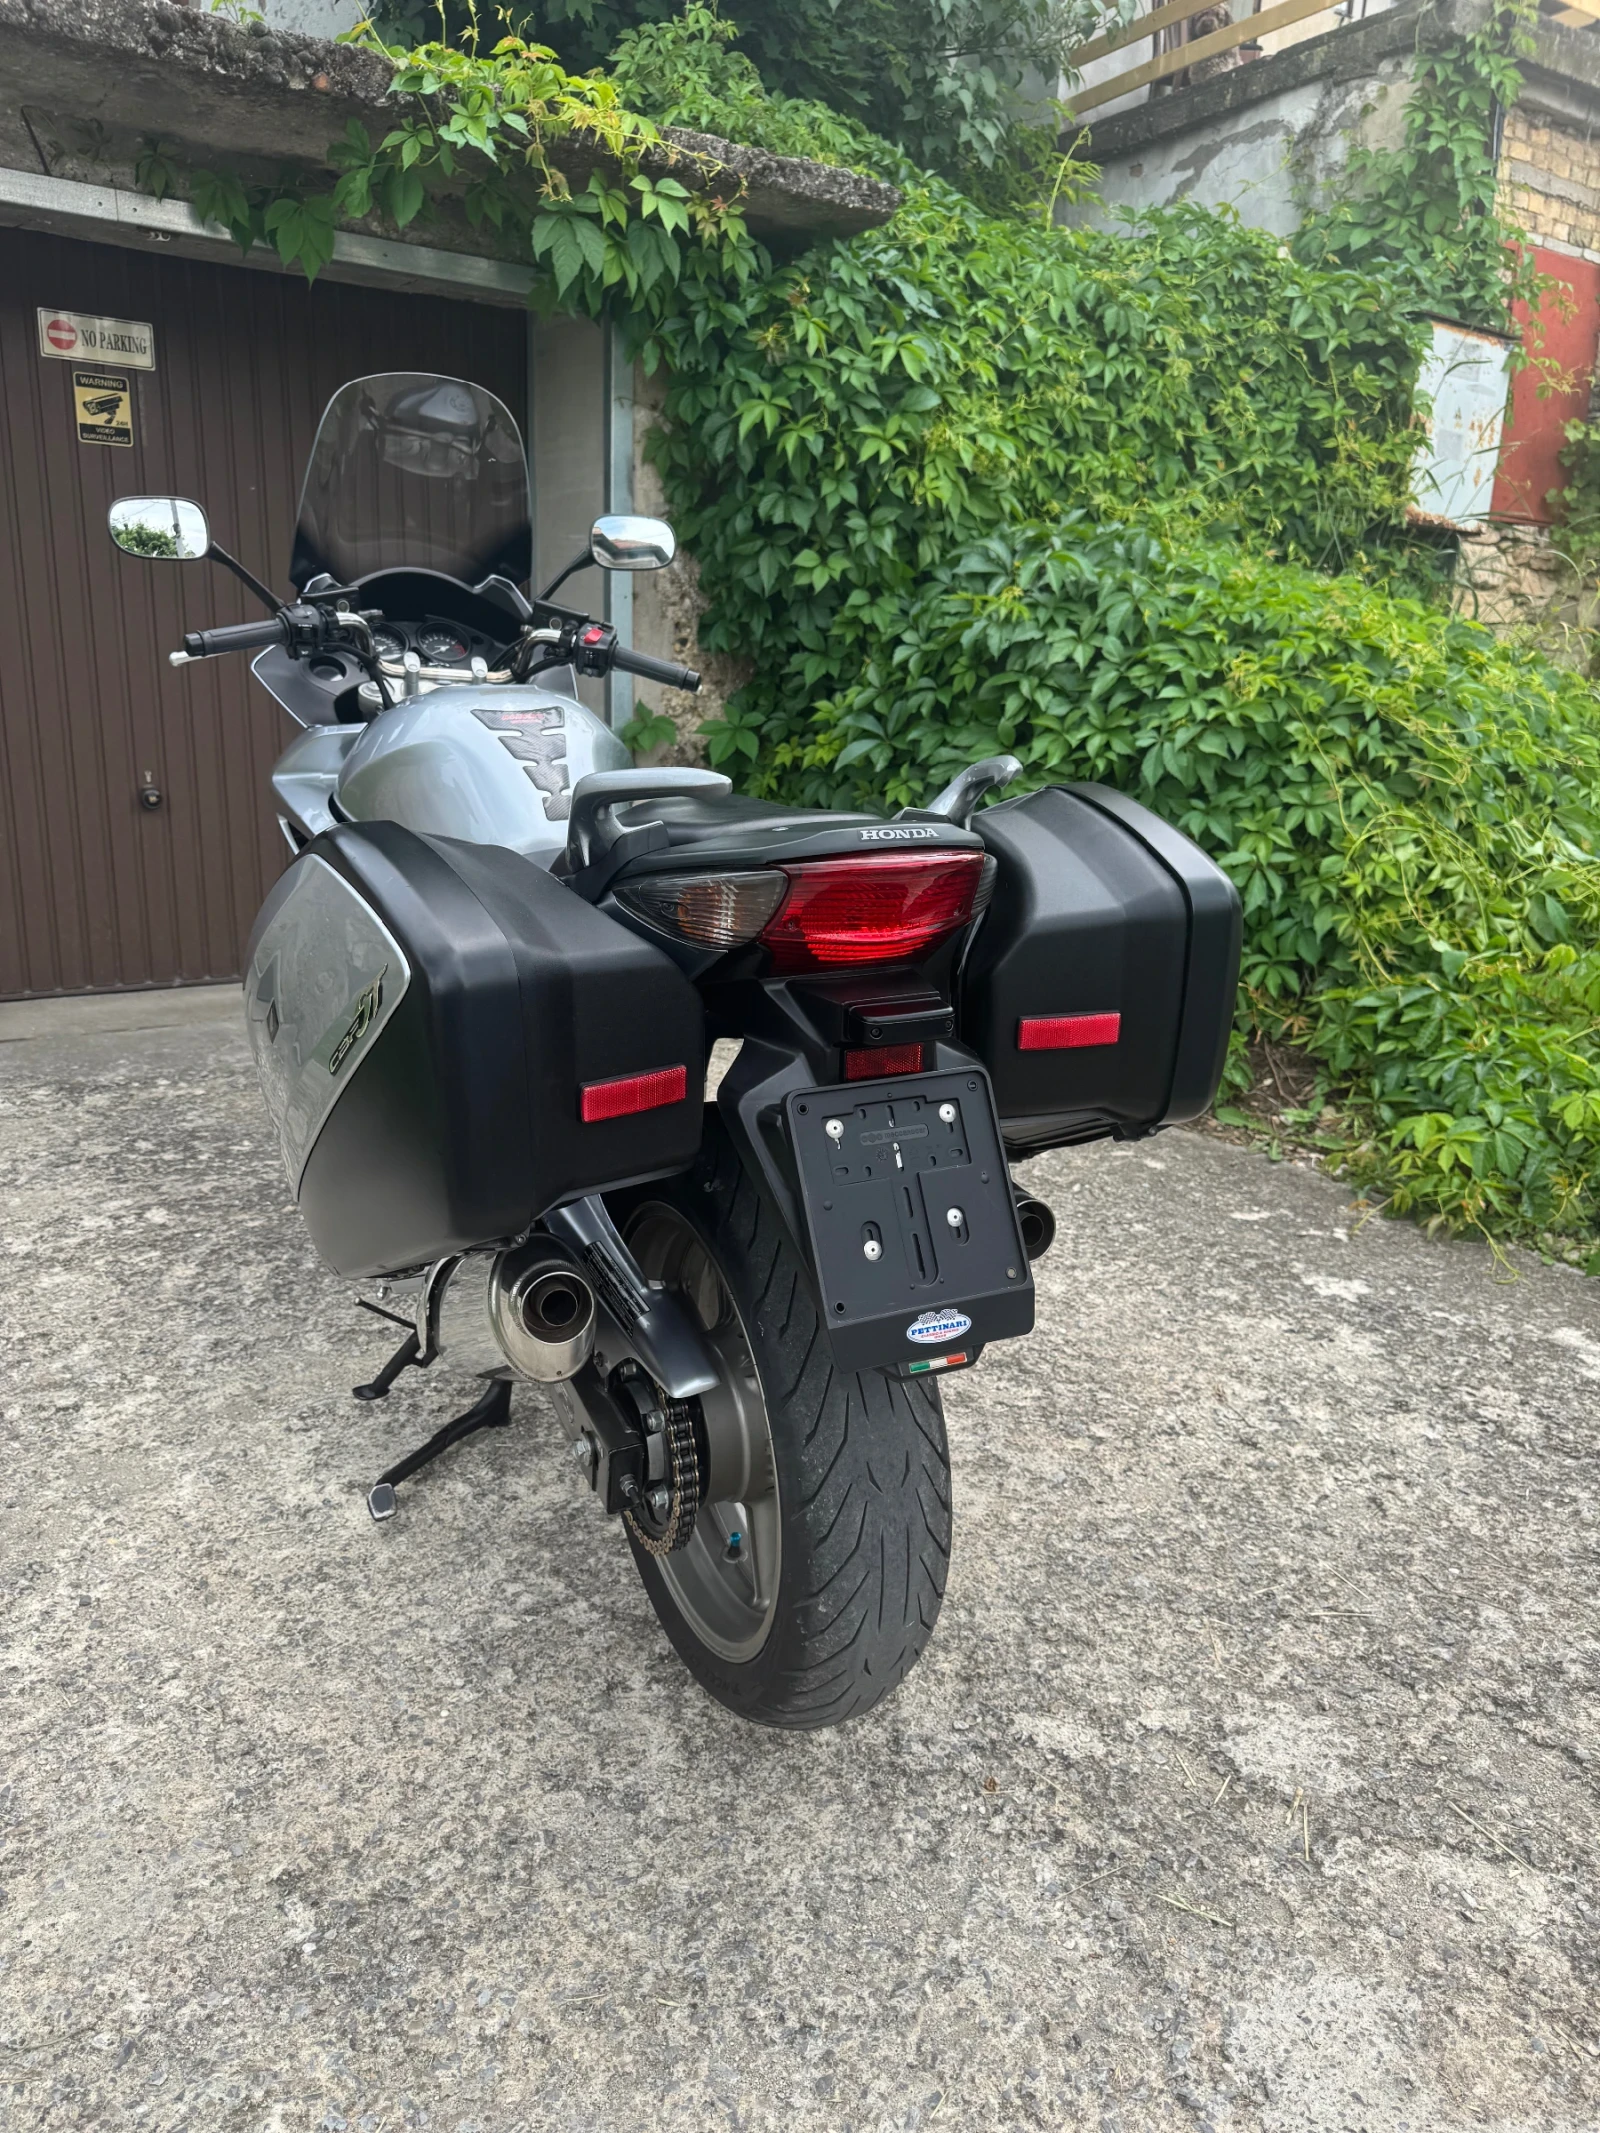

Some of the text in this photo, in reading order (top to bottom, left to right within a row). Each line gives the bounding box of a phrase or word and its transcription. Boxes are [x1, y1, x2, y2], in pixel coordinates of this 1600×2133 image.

[81, 329, 147, 354] NO PARKING
[79, 376, 124, 389] WARNING
[95, 426, 116, 435] VIDEO
[82, 433, 129, 443] SURVEILLANCE
[860, 827, 940, 841] HONDA
[910, 1319, 968, 1336] PETTINARI
